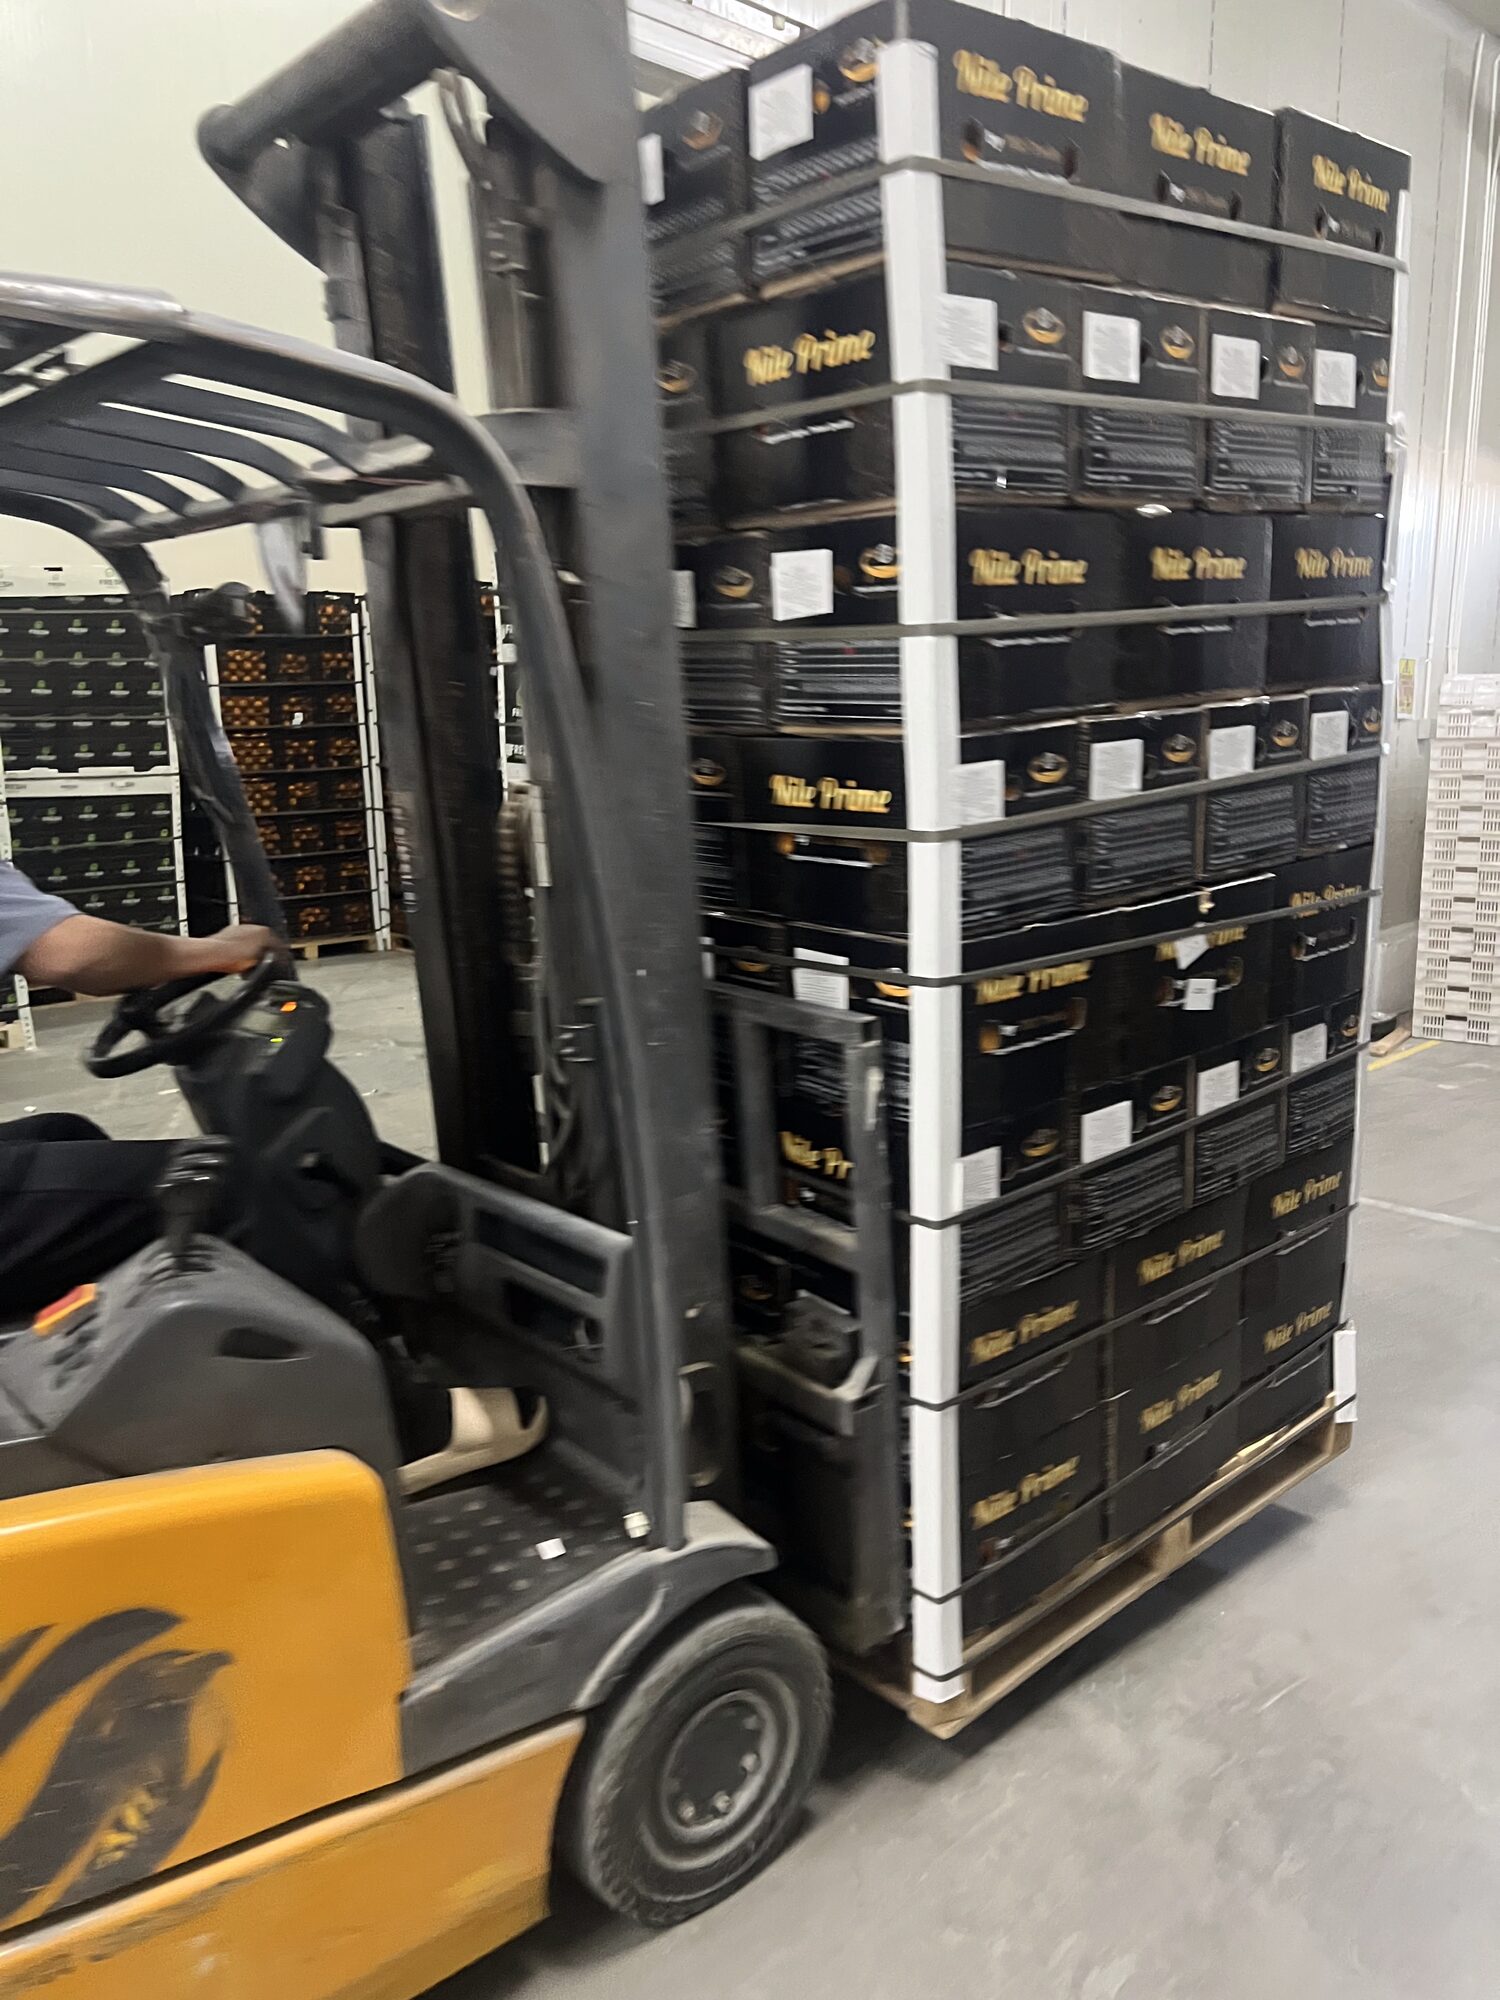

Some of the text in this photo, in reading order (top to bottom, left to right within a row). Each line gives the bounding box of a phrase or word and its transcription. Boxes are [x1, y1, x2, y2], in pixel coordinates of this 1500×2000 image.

[1013, 65, 1089, 122] Prime
[1194, 126, 1251, 176] Prime
[1347, 166, 1390, 213] Prime
[793, 329, 875, 374] Prime
[1021, 547, 1088, 586] Prime
[1192, 546, 1247, 581] Prime
[1331, 546, 1374, 578] Prime
[817, 776, 892, 814] Prime
[1303, 1171, 1342, 1203] Prime
[1177, 1230, 1226, 1267] Prime
[1018, 1300, 1080, 1344] Prime
[1295, 1301, 1333, 1337] Prime
[1176, 1369, 1223, 1411] Prime
[1018, 1455, 1081, 1502] Prime
